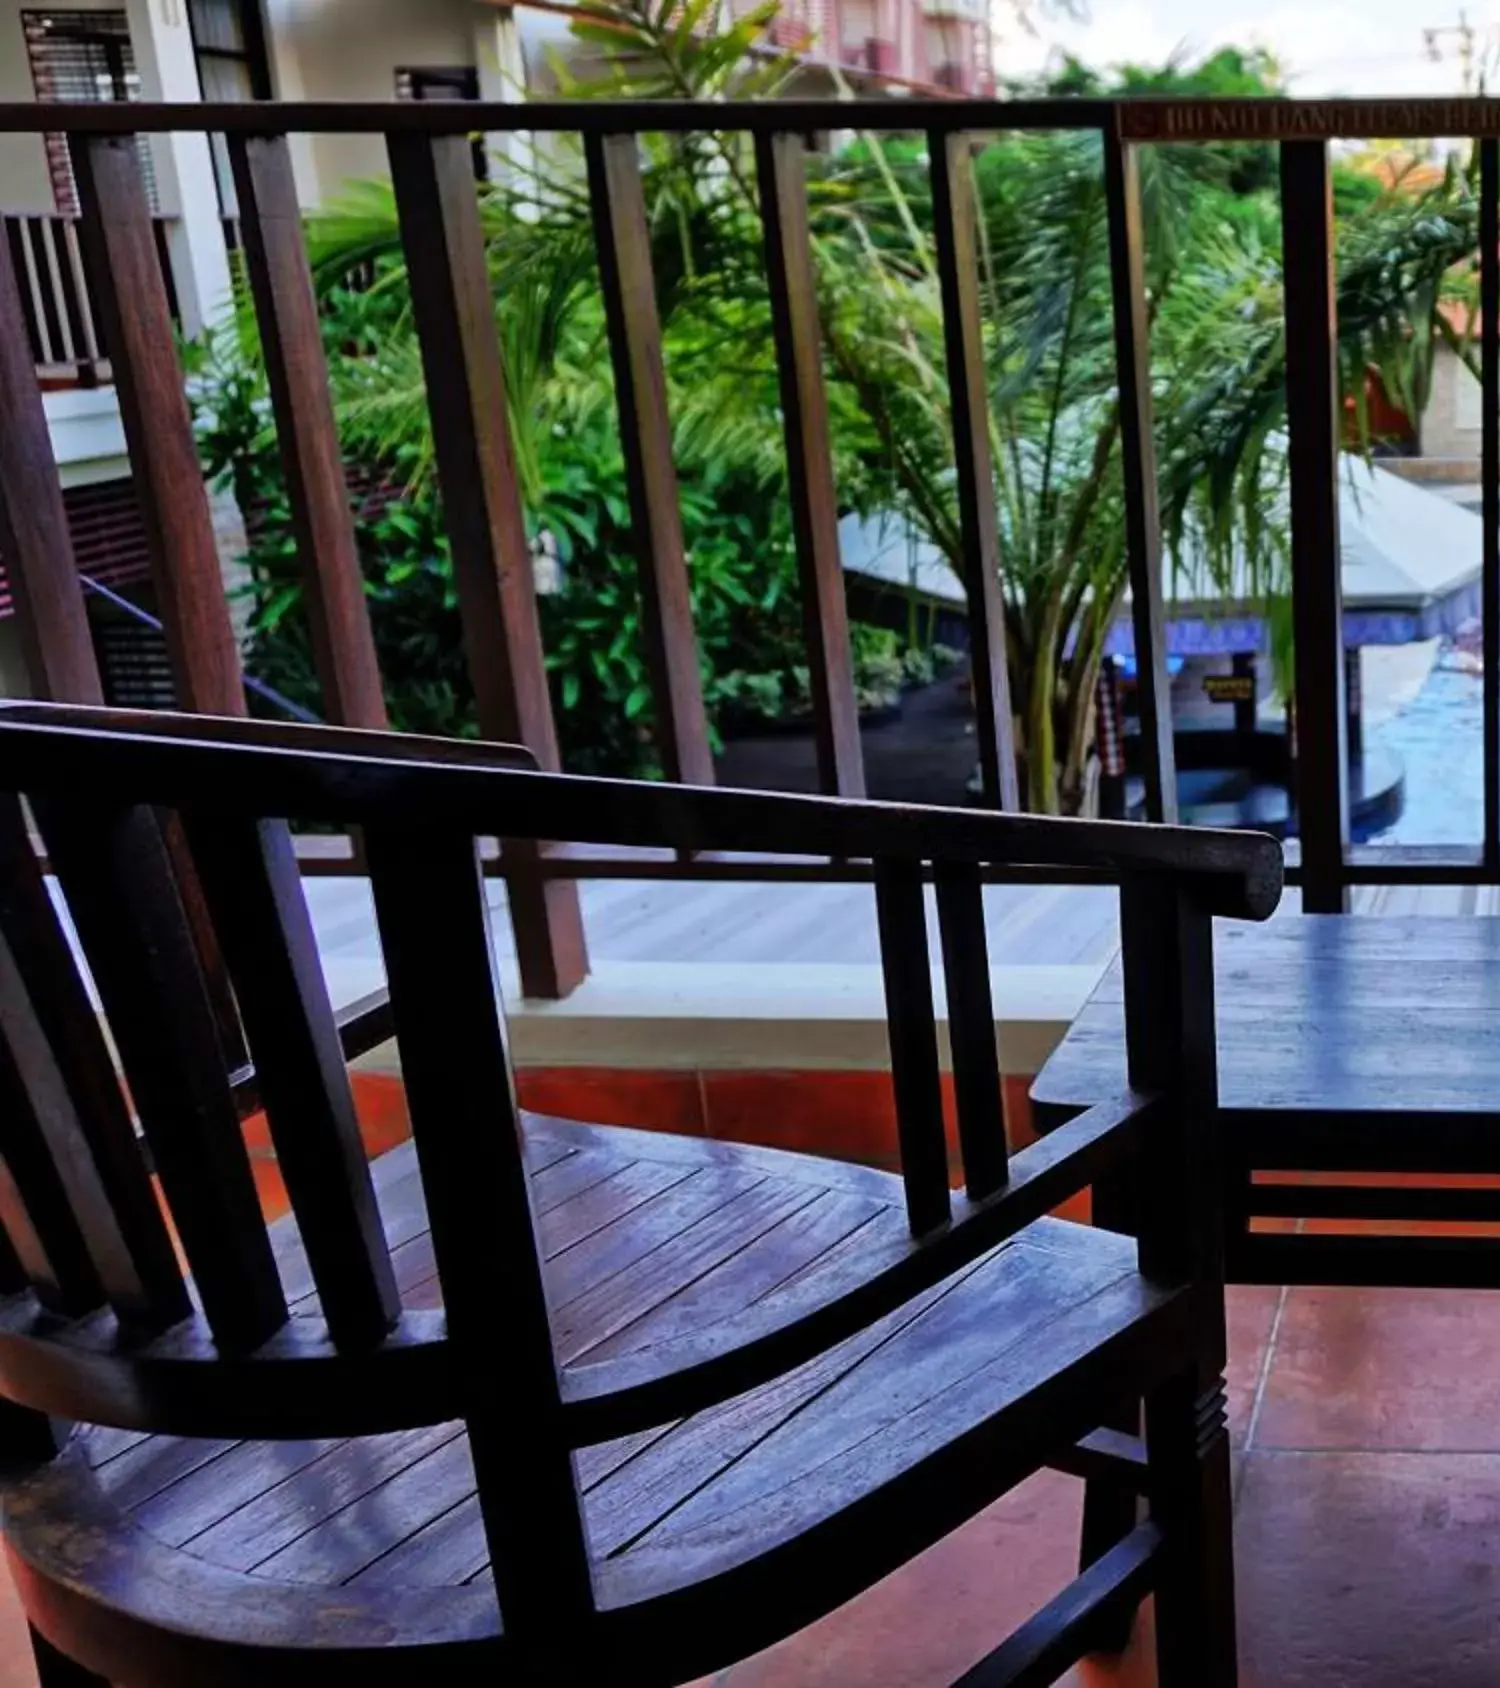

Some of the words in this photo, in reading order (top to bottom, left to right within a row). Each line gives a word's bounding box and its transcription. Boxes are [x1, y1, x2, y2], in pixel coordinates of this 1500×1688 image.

[1167, 107, 1204, 132] DO
[1211, 107, 1260, 132] NOT
[1270, 106, 1344, 133] HANG
[1354, 106, 1437, 131] ITEMS
